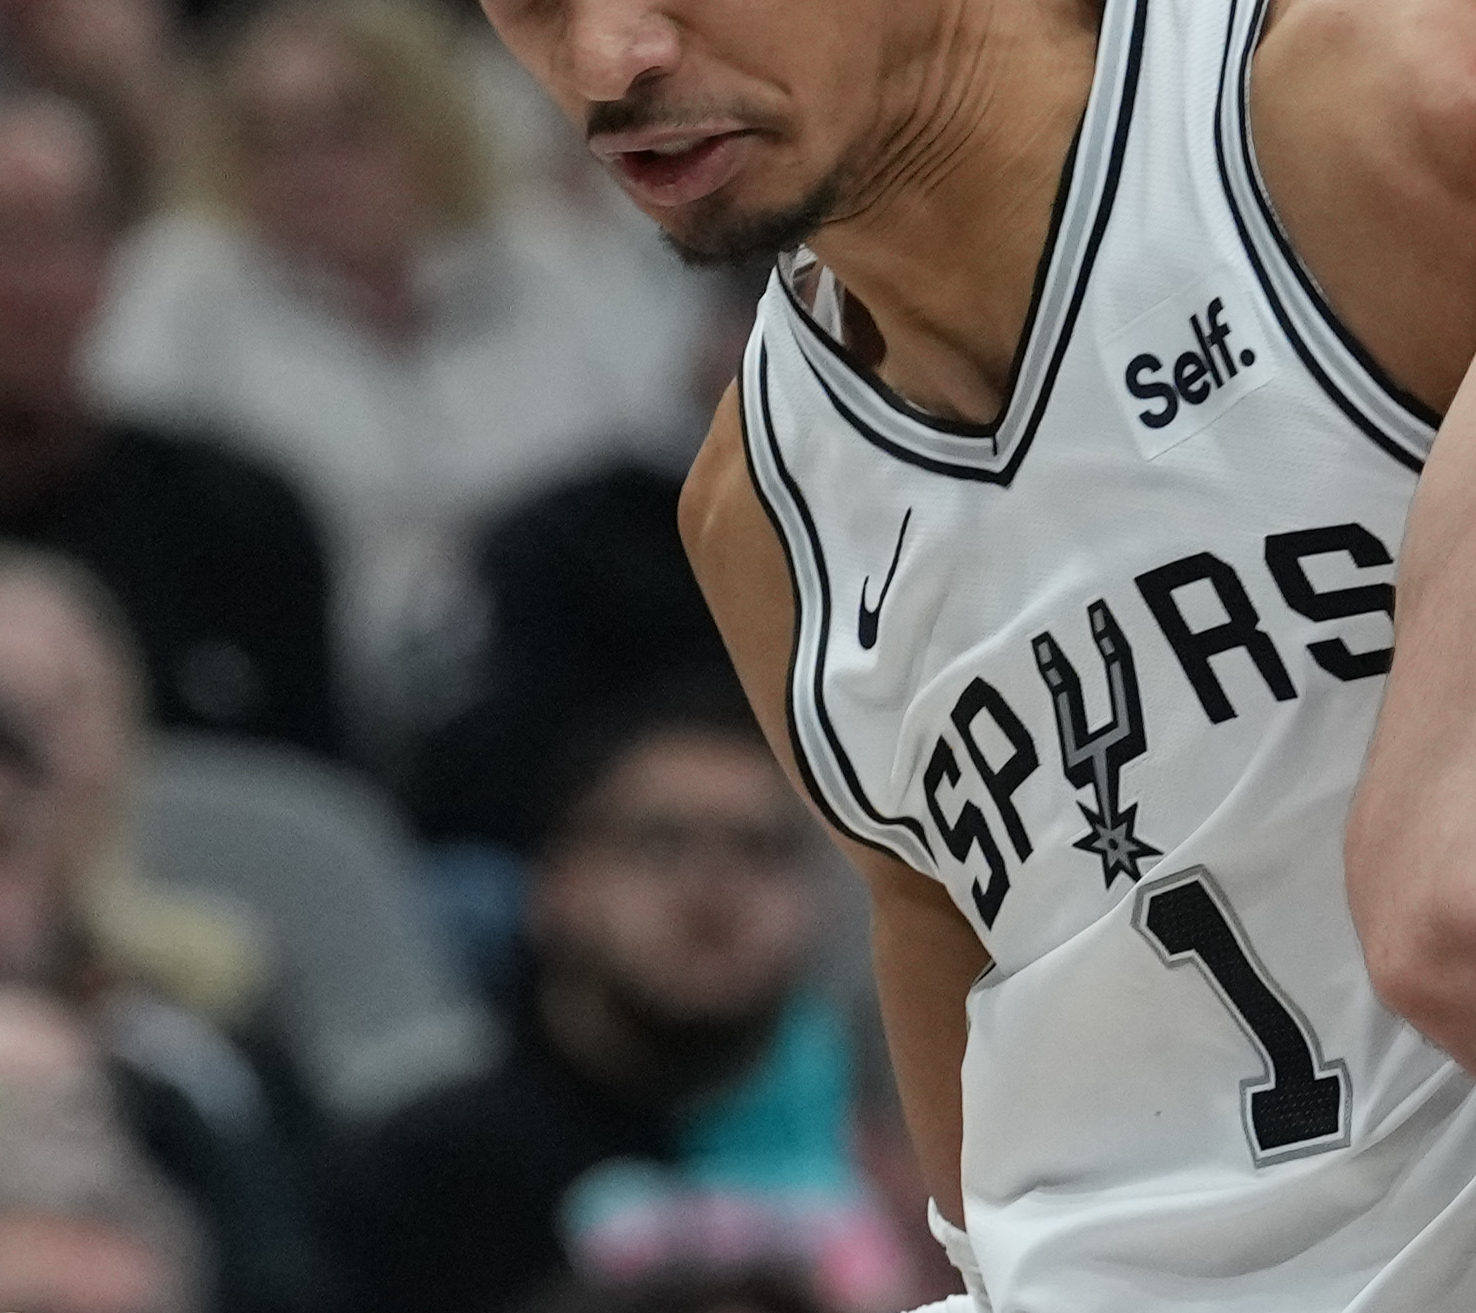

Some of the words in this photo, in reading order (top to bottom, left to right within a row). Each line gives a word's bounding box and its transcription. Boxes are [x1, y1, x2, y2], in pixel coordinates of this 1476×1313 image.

[1125, 296, 1256, 429] Self.
[924, 523, 1395, 931] SPURS
[1131, 864, 1353, 1168] 1
